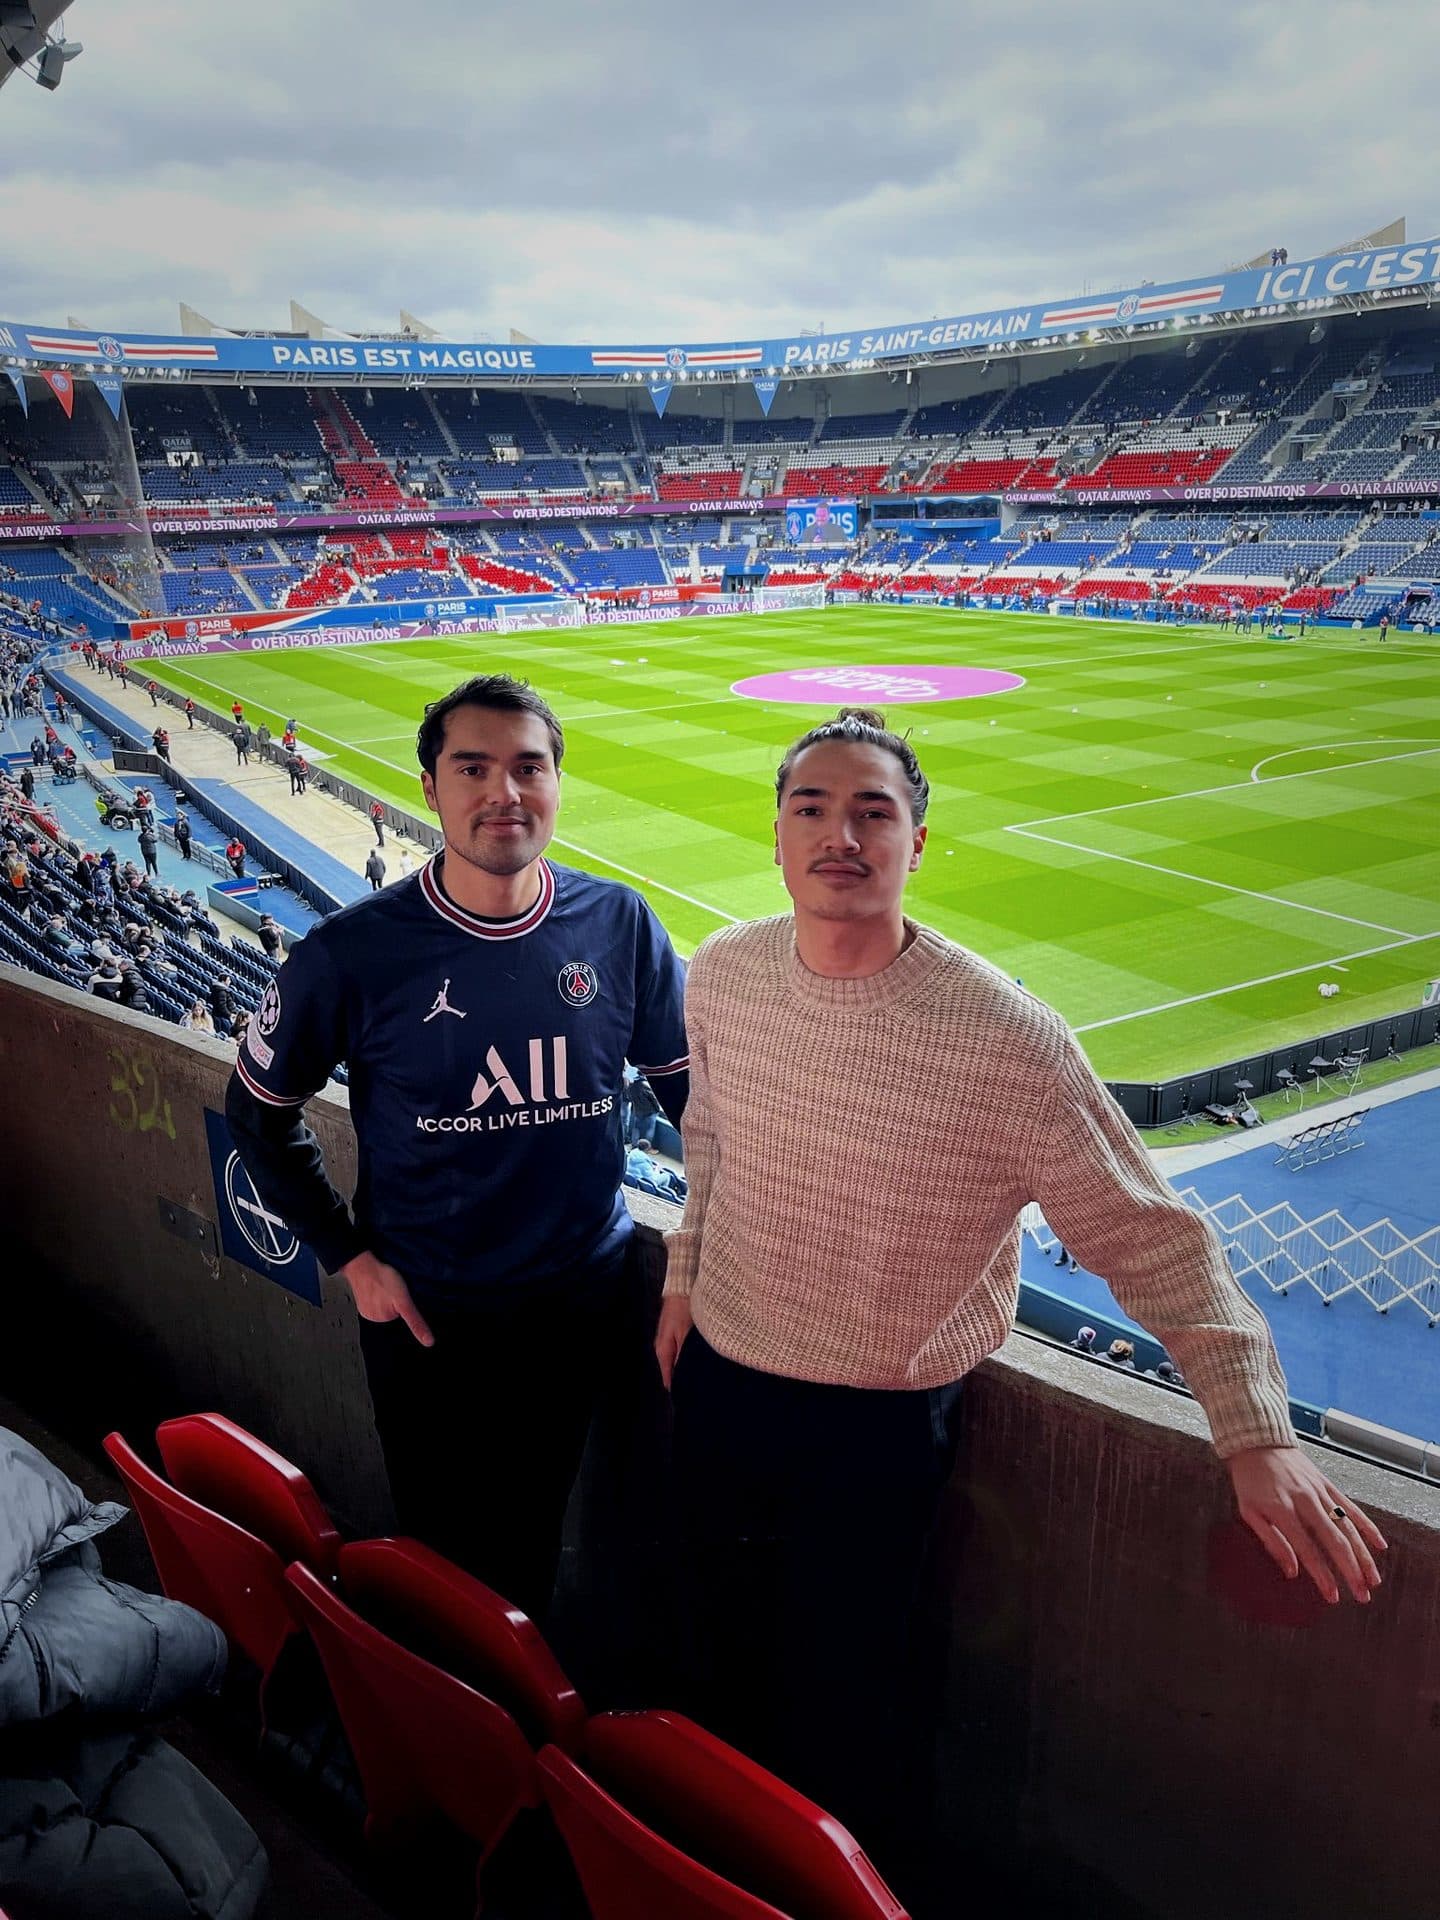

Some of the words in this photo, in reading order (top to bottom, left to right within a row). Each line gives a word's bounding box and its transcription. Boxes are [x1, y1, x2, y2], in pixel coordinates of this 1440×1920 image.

[1256, 265, 1315, 302] ICI
[785, 339, 851, 363] PARIS
[858, 312, 1032, 355] SAINT-GERMAIN
[272, 346, 357, 366] PARIS
[363, 349, 412, 367] EST
[419, 350, 536, 369] MAGIQUE
[162, 438, 192, 446] QATAR
[488, 435, 513, 444] QATAR
[1184, 487, 1211, 499] OVER
[1213, 487, 1228, 499] 150
[1230, 484, 1306, 498] DESTINATIONS
[1340, 483, 1380, 495] QATAR
[1383, 480, 1438, 494] AIRWAYS
[1006, 494, 1028, 502] QATAR
[1078, 491, 1109, 501] QATAR
[1110, 490, 1152, 501] AIRWAYS
[513, 508, 538, 519] OVER
[539, 508, 553, 518] 150
[554, 506, 619, 517] DESTINATIONS
[689, 502, 721, 512] QATAR
[723, 500, 764, 510] AIRWAYS
[152, 521, 183, 532] OVER
[184, 521, 201, 531] 150
[203, 518, 278, 530] DESTINATIONS
[357, 514, 392, 525] QATAR
[393, 512, 436, 523] AIRWAYS
[15, 525, 62, 537] AIRWAYS
[653, 589, 679, 598] PARIS
[437, 602, 467, 612] PARIS
[707, 602, 739, 614] QATAR
[589, 612, 606, 624] 150
[609, 606, 681, 622] DESTINATIONS
[200, 619, 232, 630] PARIS
[251, 636, 290, 649] OVER
[290, 634, 309, 647] 150
[311, 627, 401, 645] DESTINATIONS
[150, 642, 208, 657] AIRWAYS
[562, 964, 590, 976] PARIS
[416, 1115, 483, 1133] ACCOR
[488, 1111, 530, 1130] LIVE
[534, 1096, 613, 1125] LIMITLESS
